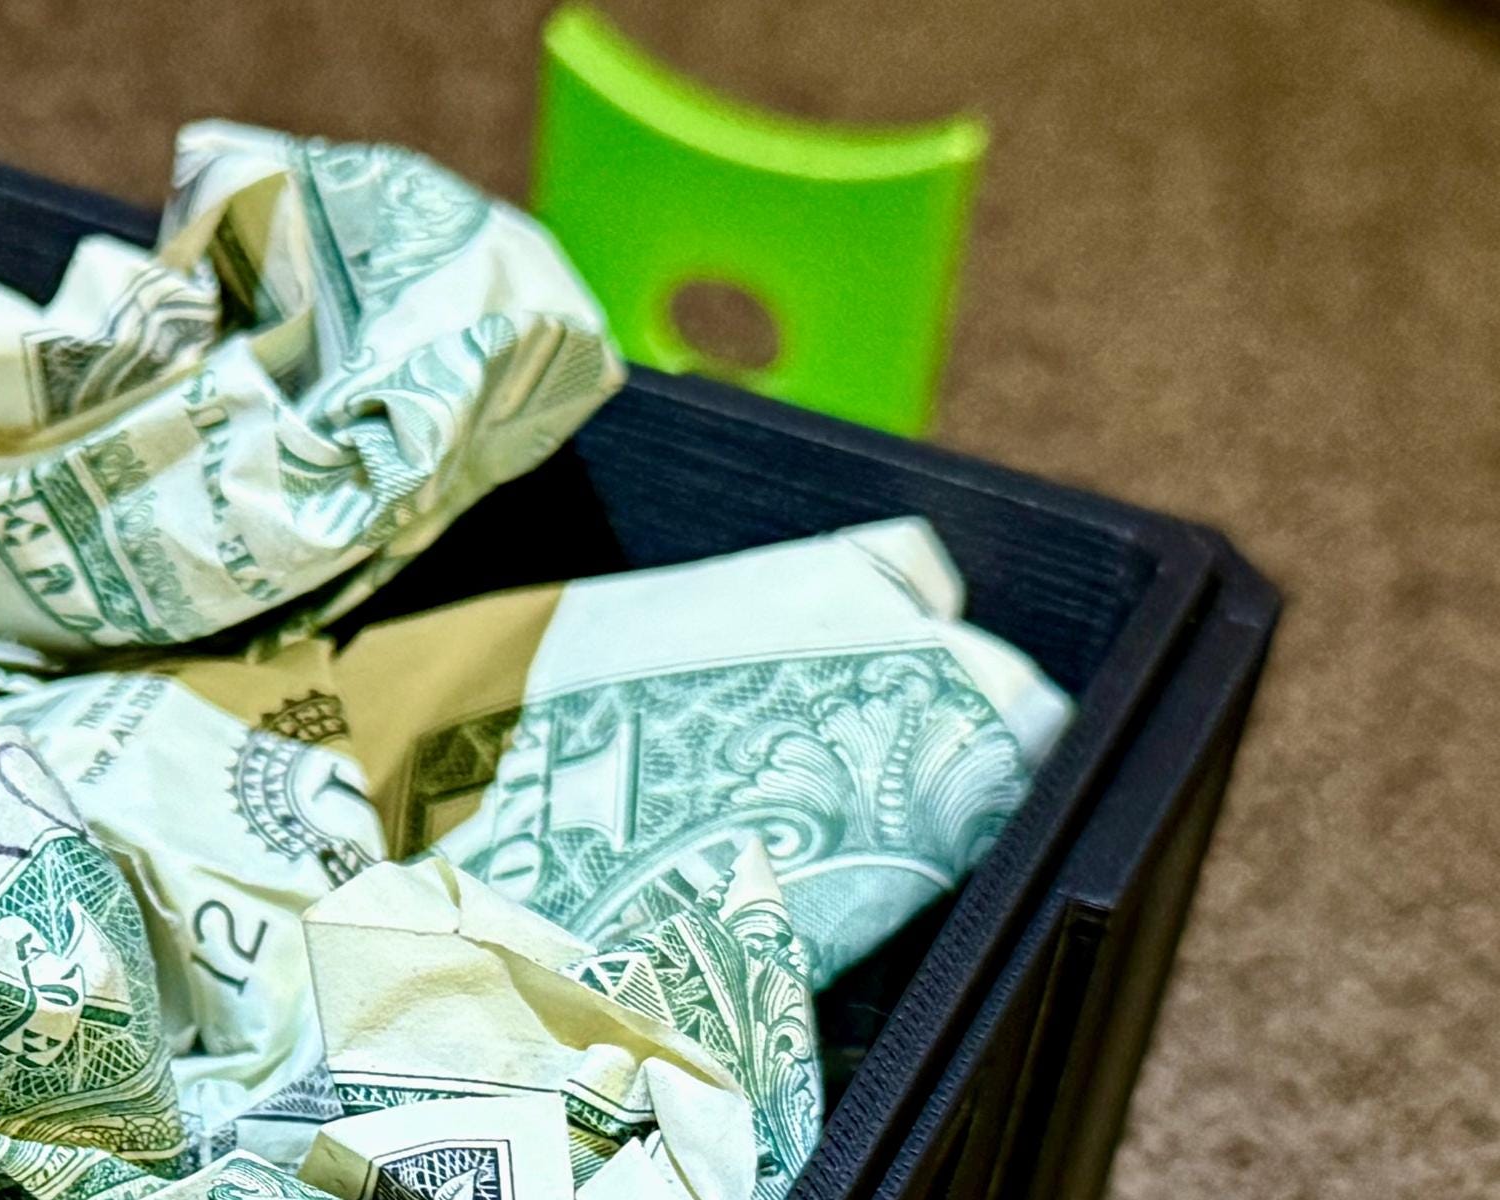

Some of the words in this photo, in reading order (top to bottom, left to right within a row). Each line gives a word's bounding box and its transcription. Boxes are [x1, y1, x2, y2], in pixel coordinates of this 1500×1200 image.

[77, 750, 119, 784] FOR
[108, 714, 144, 748] ALL
[189, 899, 269, 996] 12
